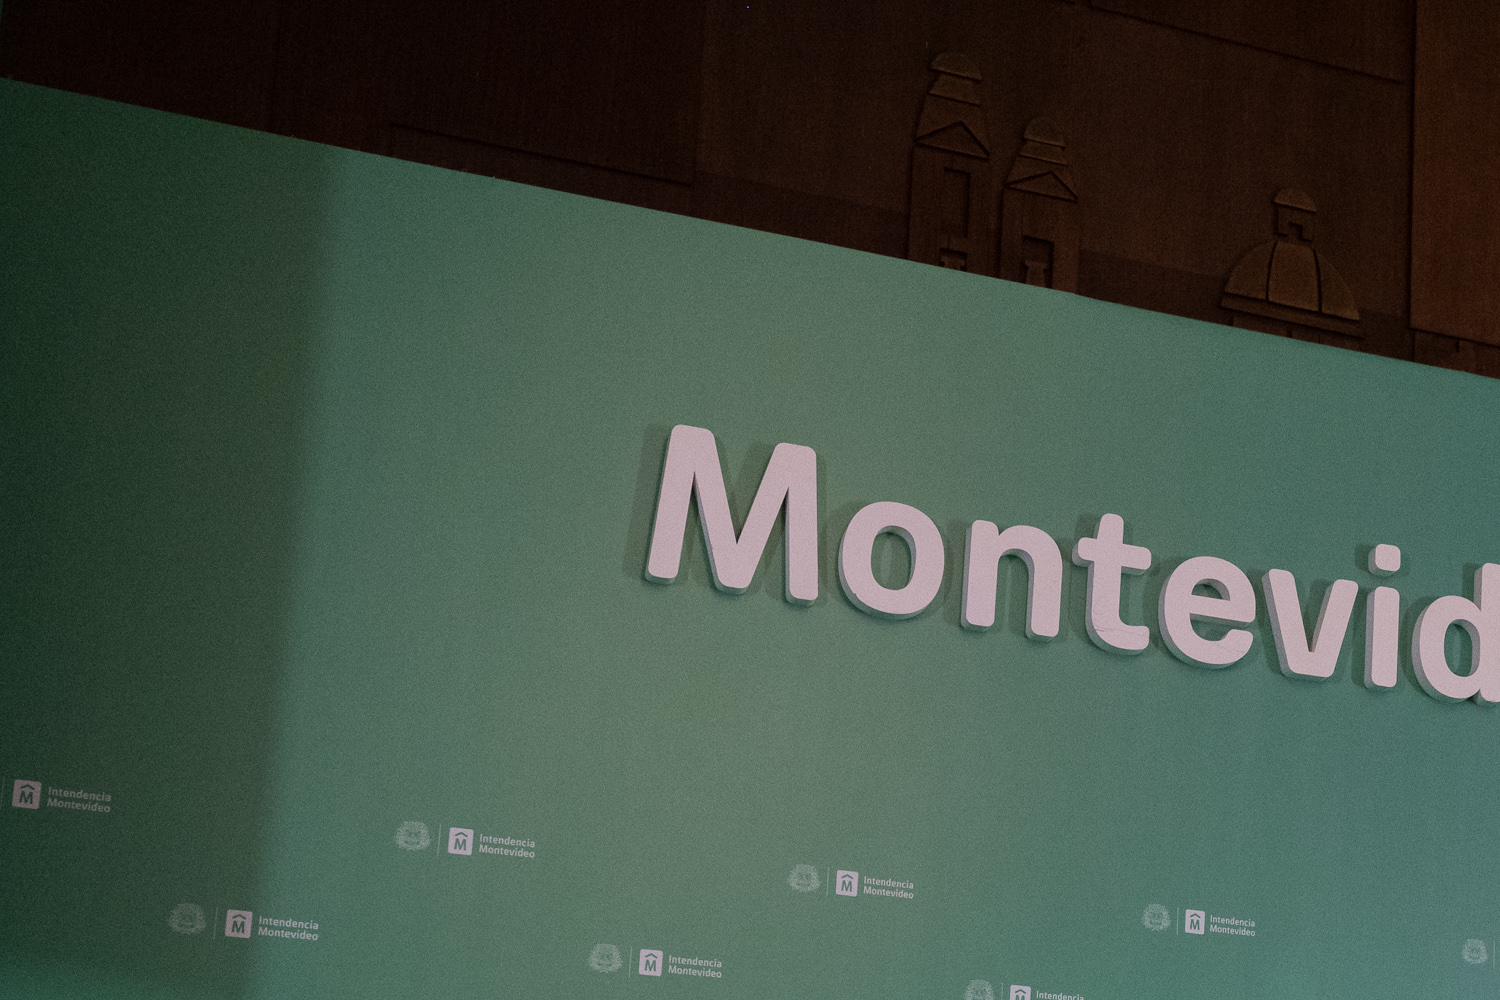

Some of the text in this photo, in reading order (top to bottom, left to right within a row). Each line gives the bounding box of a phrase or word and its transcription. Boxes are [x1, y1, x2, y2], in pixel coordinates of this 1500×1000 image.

[48, 786, 111, 802] Intendencia
[47, 798, 111, 813] Montevideo
[480, 834, 535, 848] Intendencia
[479, 844, 535, 858] Montevideo
[864, 876, 914, 889] Intendencia
[863, 886, 914, 899] Montevideo
[259, 916, 319, 930] Intendencia
[1210, 915, 1255, 927] Intendencia
[258, 927, 319, 941] Montevideo
[1210, 924, 1255, 937] Montevideo
[669, 955, 722, 968] Intendencia
[668, 965, 722, 978] Montevideo
